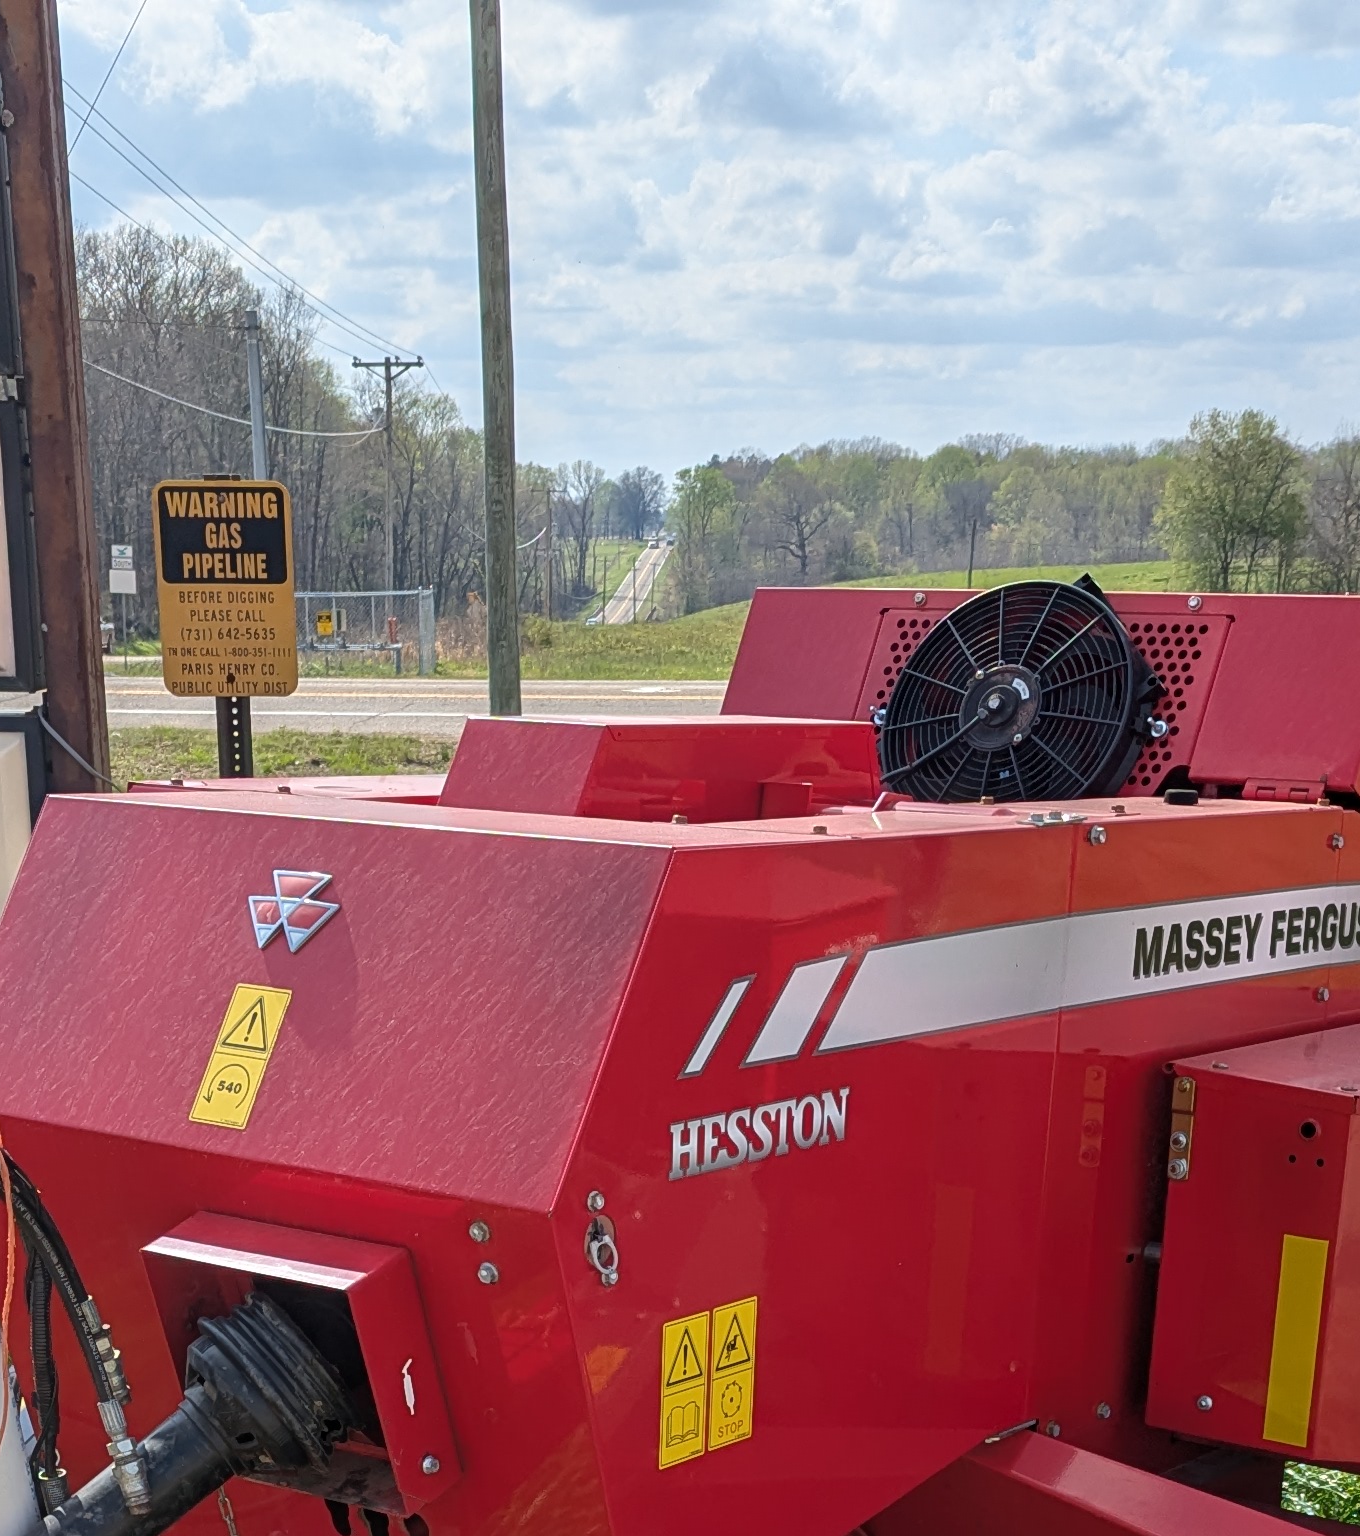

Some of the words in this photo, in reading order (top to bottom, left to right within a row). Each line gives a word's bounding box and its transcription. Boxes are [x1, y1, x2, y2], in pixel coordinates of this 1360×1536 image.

[164, 491, 278, 518] WARNING
[205, 522, 242, 549] GAS
[182, 552, 268, 579] PIPELINE
[179, 591, 222, 604] BEFORE
[227, 591, 275, 604] DIGGING
[190, 609, 232, 622] PLEASE
[237, 610, 266, 622] CALL
[181, 628, 213, 642] (731)
[217, 627, 276, 640] 642-5635
[181, 647, 198, 657] ONE
[200, 647, 220, 657] CALL
[224, 647, 291, 658] 1-800-351-1111
[181, 663, 214, 675] PARIS
[219, 663, 256, 675] HENRY
[261, 664, 280, 676] CO.
[172, 682, 213, 694] PUBLIC
[217, 682, 259, 694] UTILITY
[1132, 913, 1263, 980] MASSEY
[216, 1080, 242, 1094] 540
[669, 1087, 851, 1181] HESSTON
[717, 1420, 744, 1439] STOP
